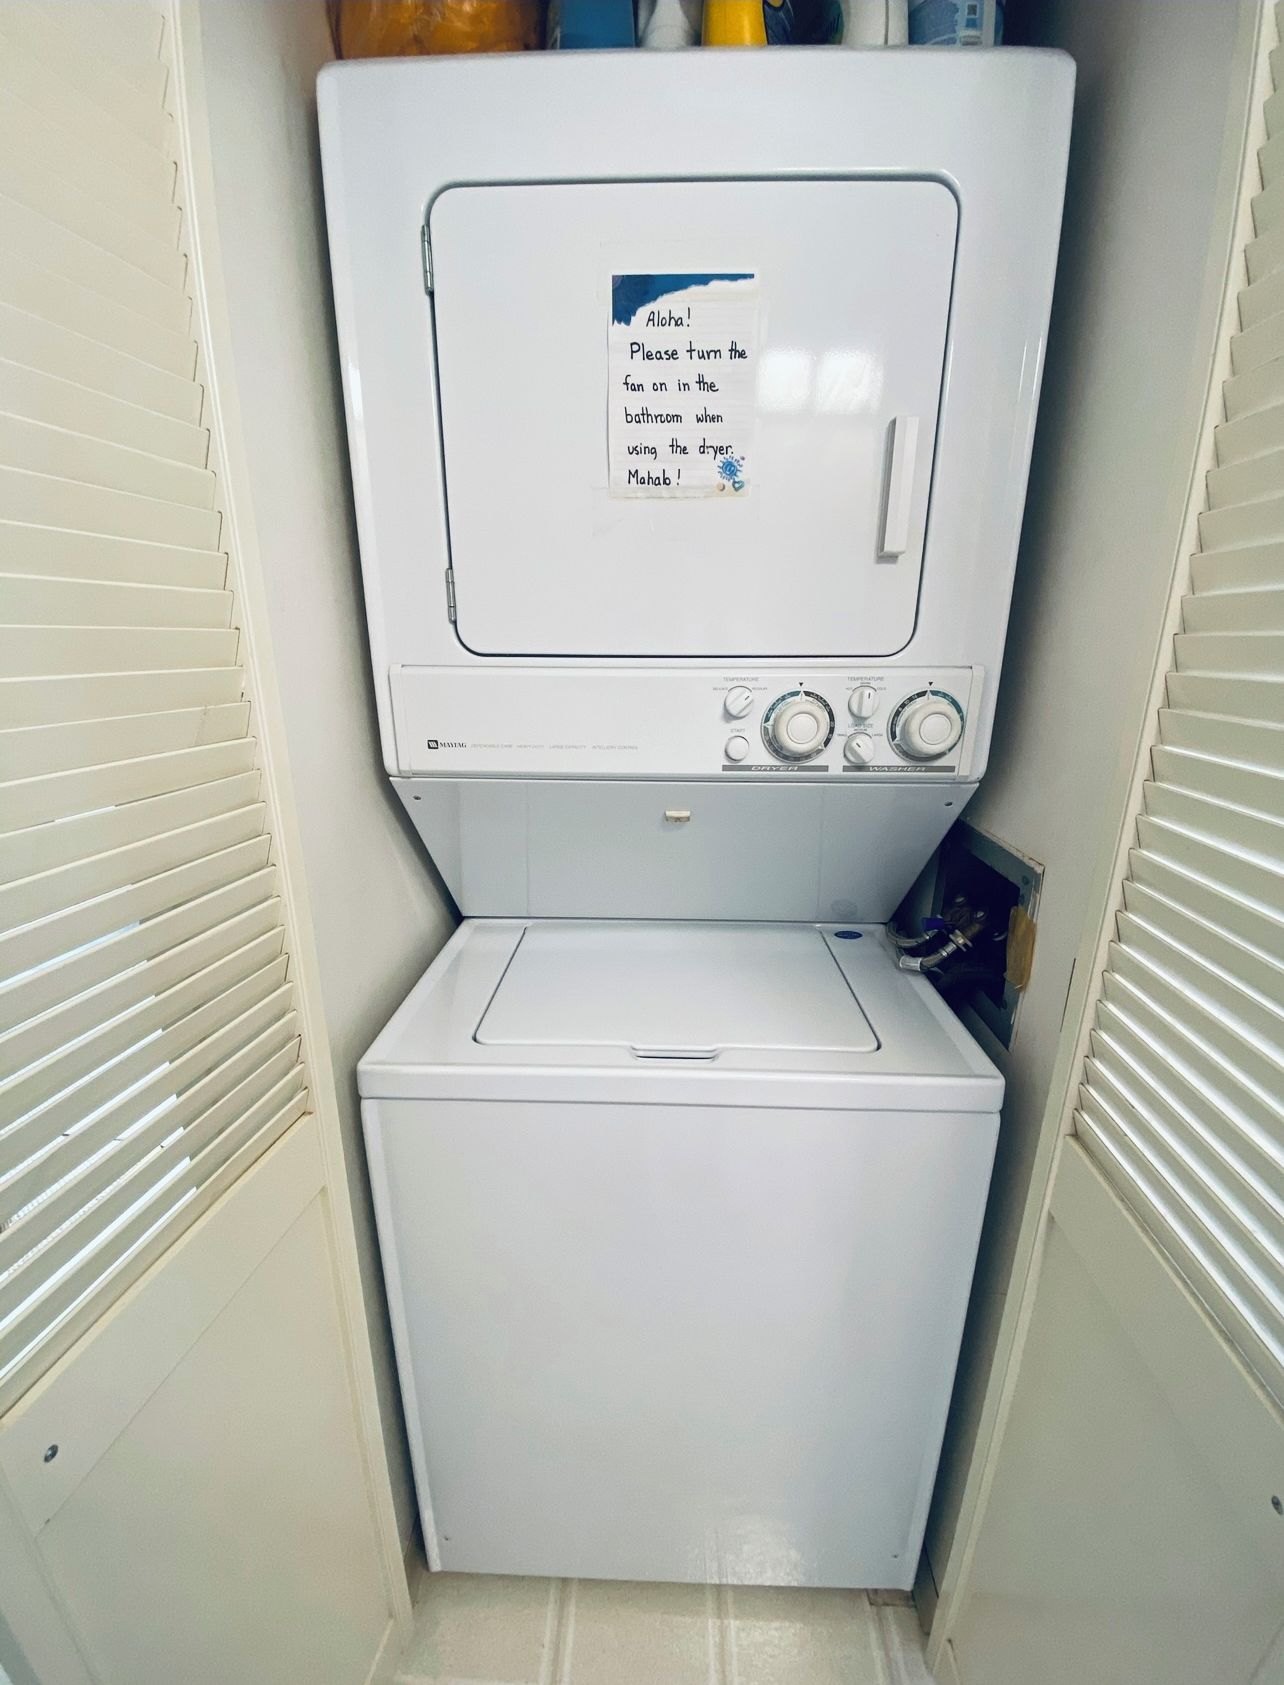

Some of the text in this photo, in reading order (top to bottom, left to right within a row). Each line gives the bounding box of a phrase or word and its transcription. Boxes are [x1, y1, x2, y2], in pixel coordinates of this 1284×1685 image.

[645, 306, 690, 328] Aloha!
[629, 340, 748, 361] Please turn the
[622, 373, 720, 393] fan on in the
[624, 406, 724, 425] bathroom when
[627, 437, 734, 461] using the dryer.
